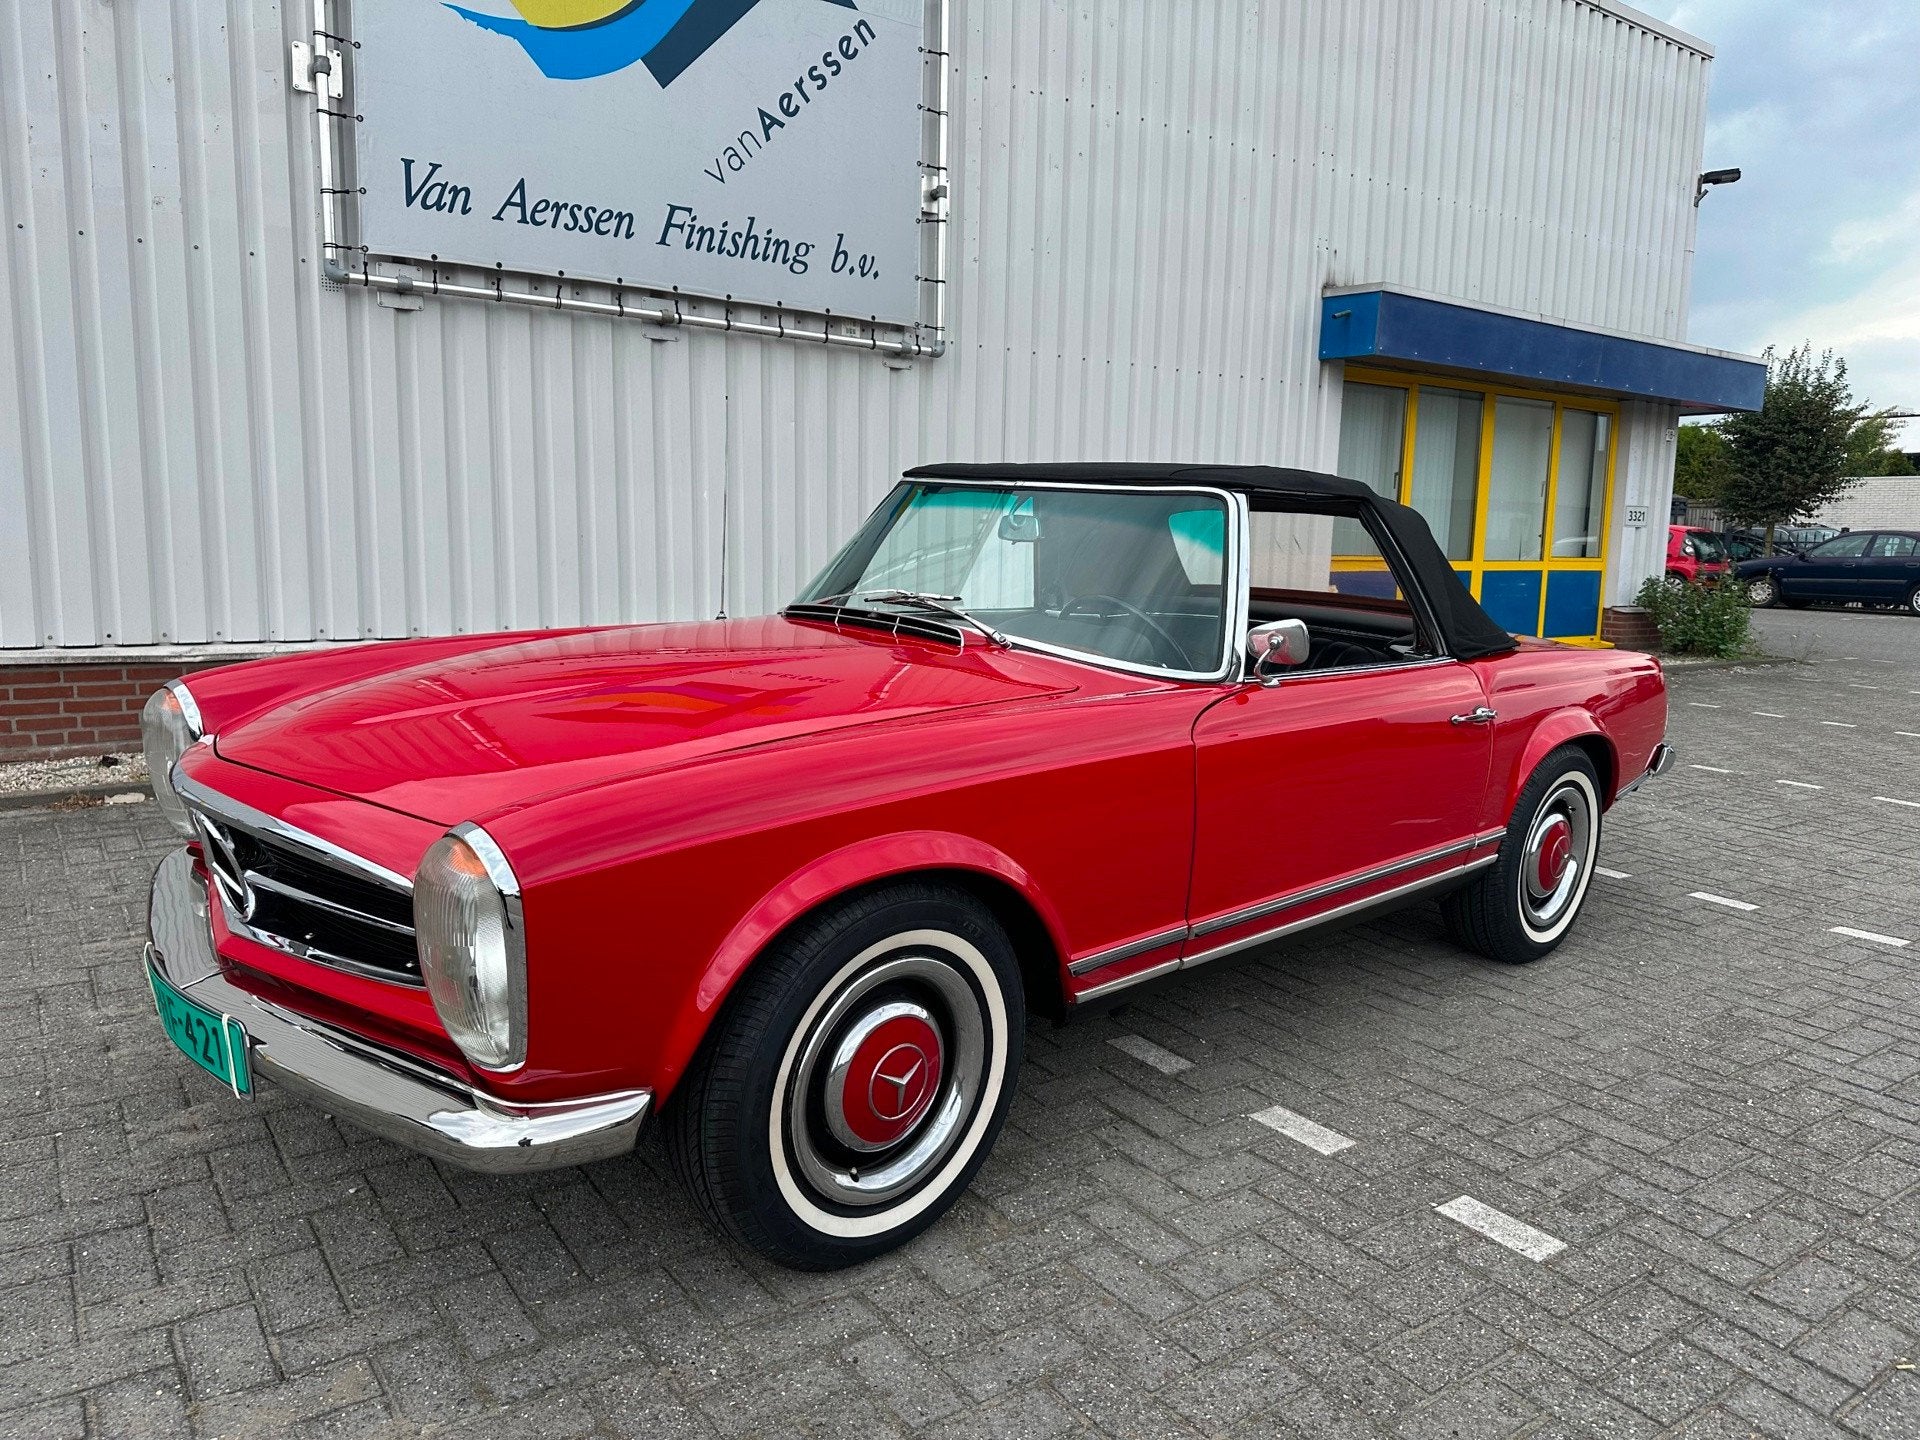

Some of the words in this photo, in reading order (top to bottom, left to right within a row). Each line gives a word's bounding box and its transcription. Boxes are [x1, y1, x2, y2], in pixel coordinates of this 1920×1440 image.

[401, 158, 472, 215] Van
[492, 178, 634, 239] Aerssen
[656, 204, 815, 274] Finishing
[831, 233, 879, 280] b.v.
[1628, 511, 1646, 522] 3321
